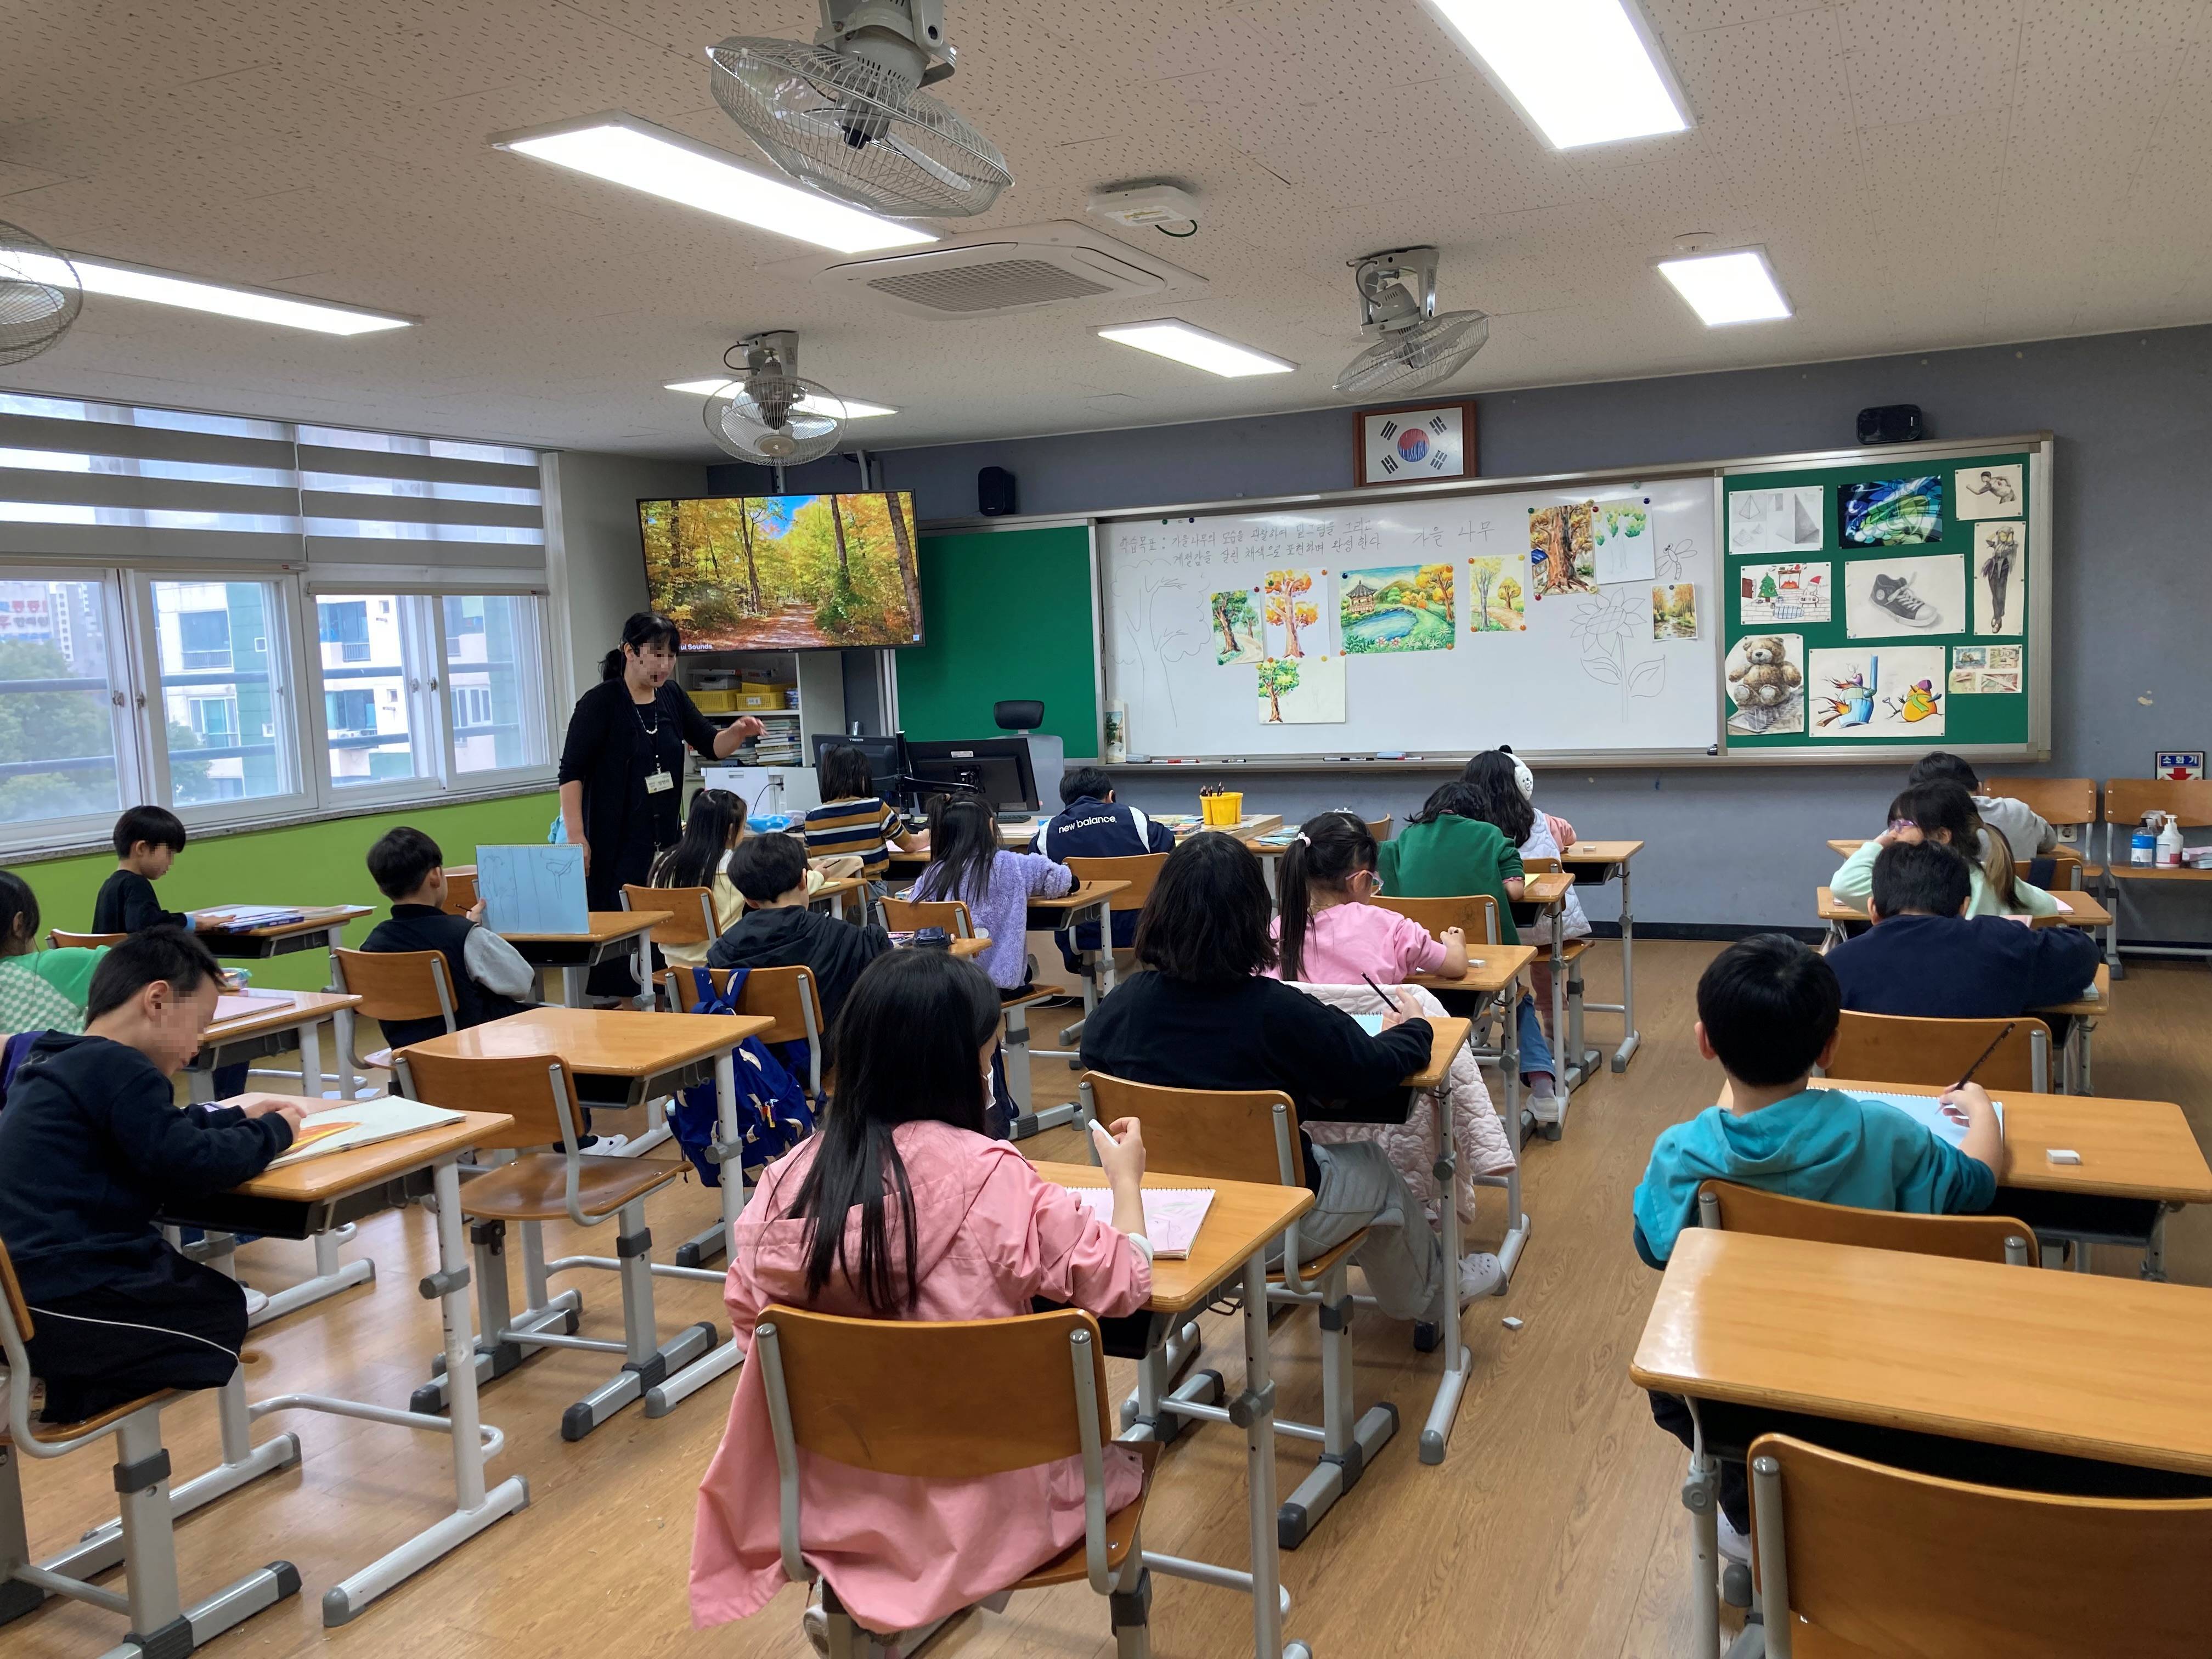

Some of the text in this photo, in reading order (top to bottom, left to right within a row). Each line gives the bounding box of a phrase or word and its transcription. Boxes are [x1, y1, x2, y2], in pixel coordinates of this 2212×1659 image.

[1120, 535, 1156, 554] 학습목표
[1171, 532, 1216, 548] 가을나무의
[1222, 530, 1244, 544] 모습을
[1251, 526, 1287, 542] 관찰하여
[1343, 517, 1373, 534] 그리고
[1412, 520, 1496, 548] 가을 나무
[1173, 533, 1381, 567] 계절감을 살린 채색으로 표현하며 완성한다
[2163, 755, 2198, 764] 소화기
[1058, 816, 1116, 834] new balance
